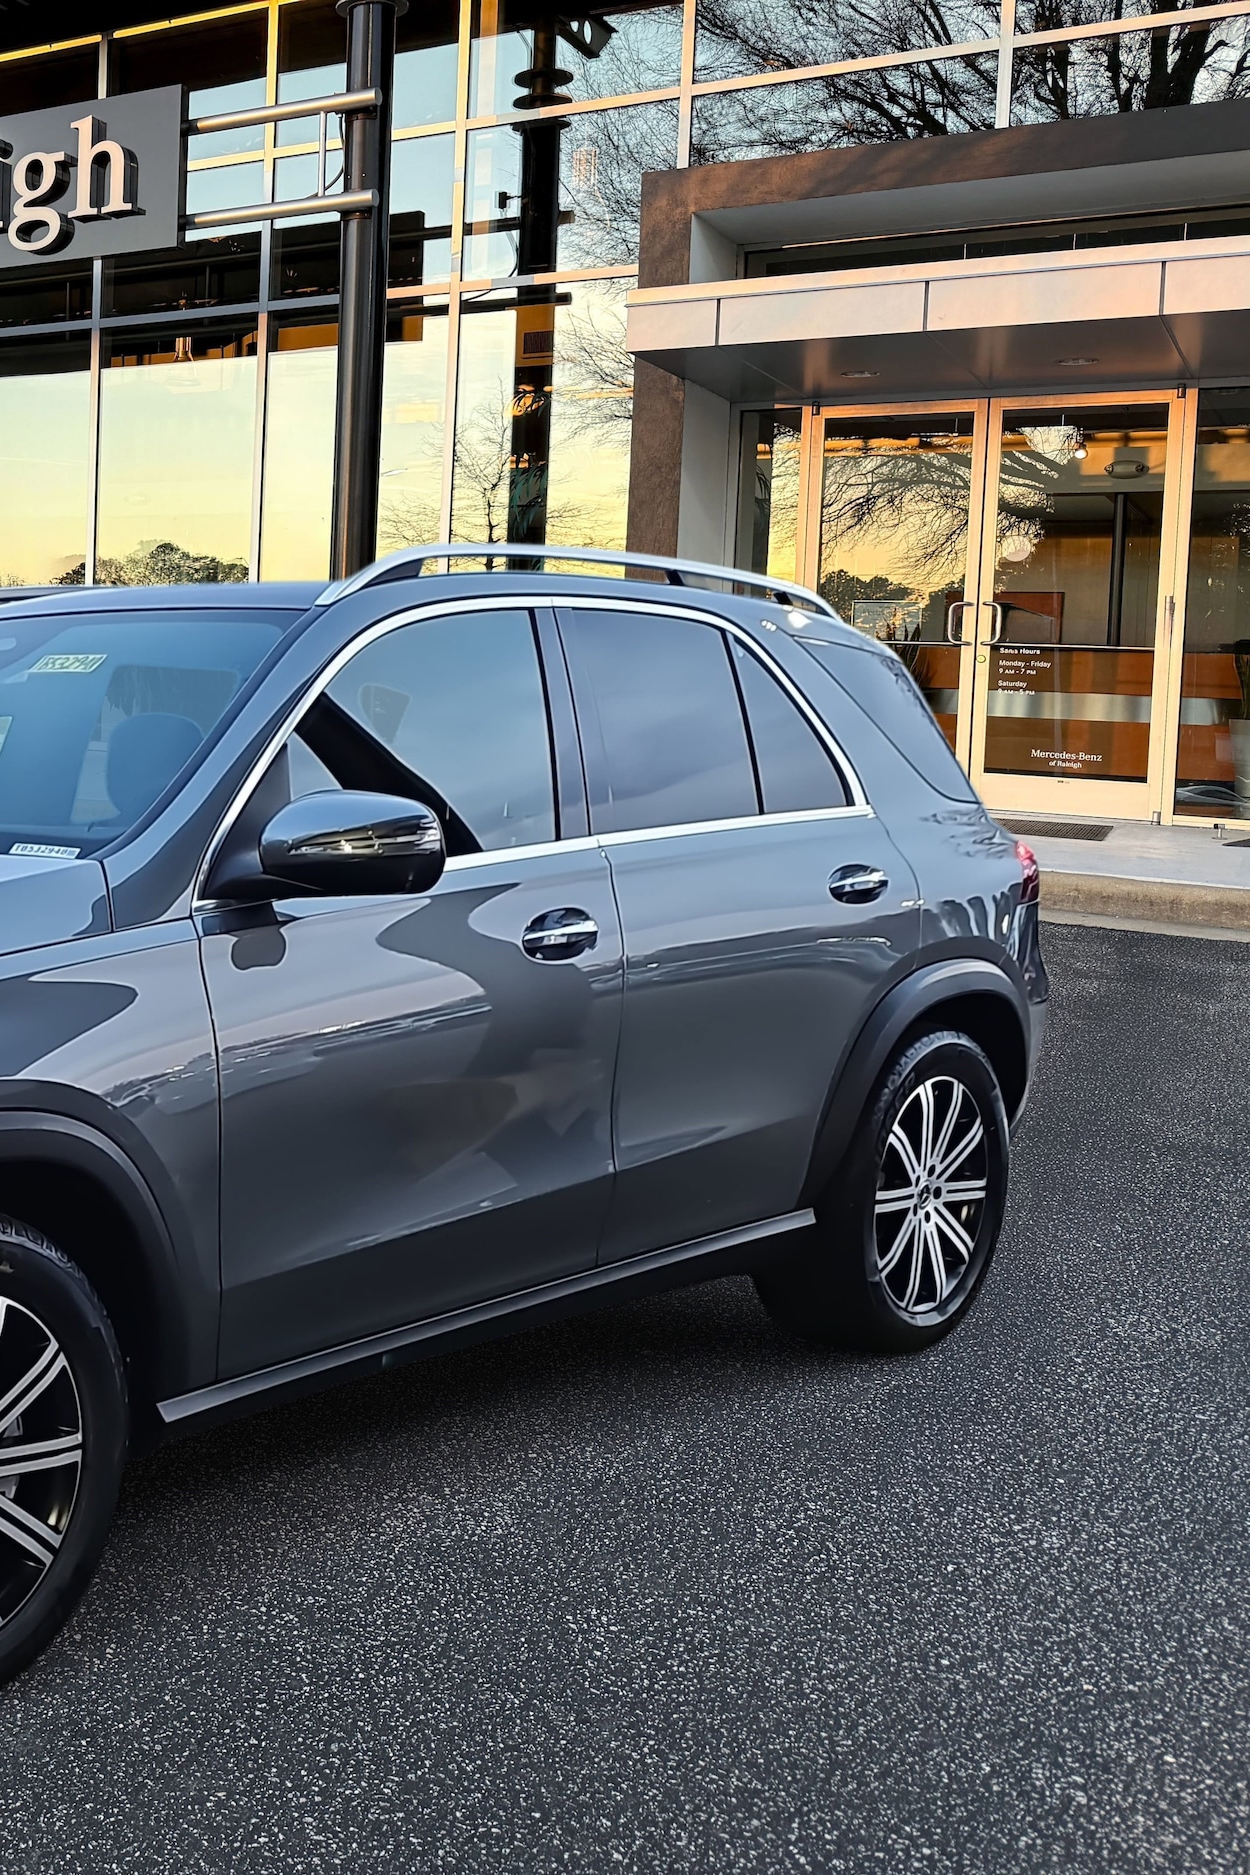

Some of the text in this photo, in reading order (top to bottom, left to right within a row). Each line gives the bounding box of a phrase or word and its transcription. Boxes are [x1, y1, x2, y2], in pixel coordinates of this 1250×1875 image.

[998, 680, 1027, 688] Saturday
[1031, 749, 1103, 761] Mercedes-Benz
[1056, 760, 1083, 769] Raleigh
